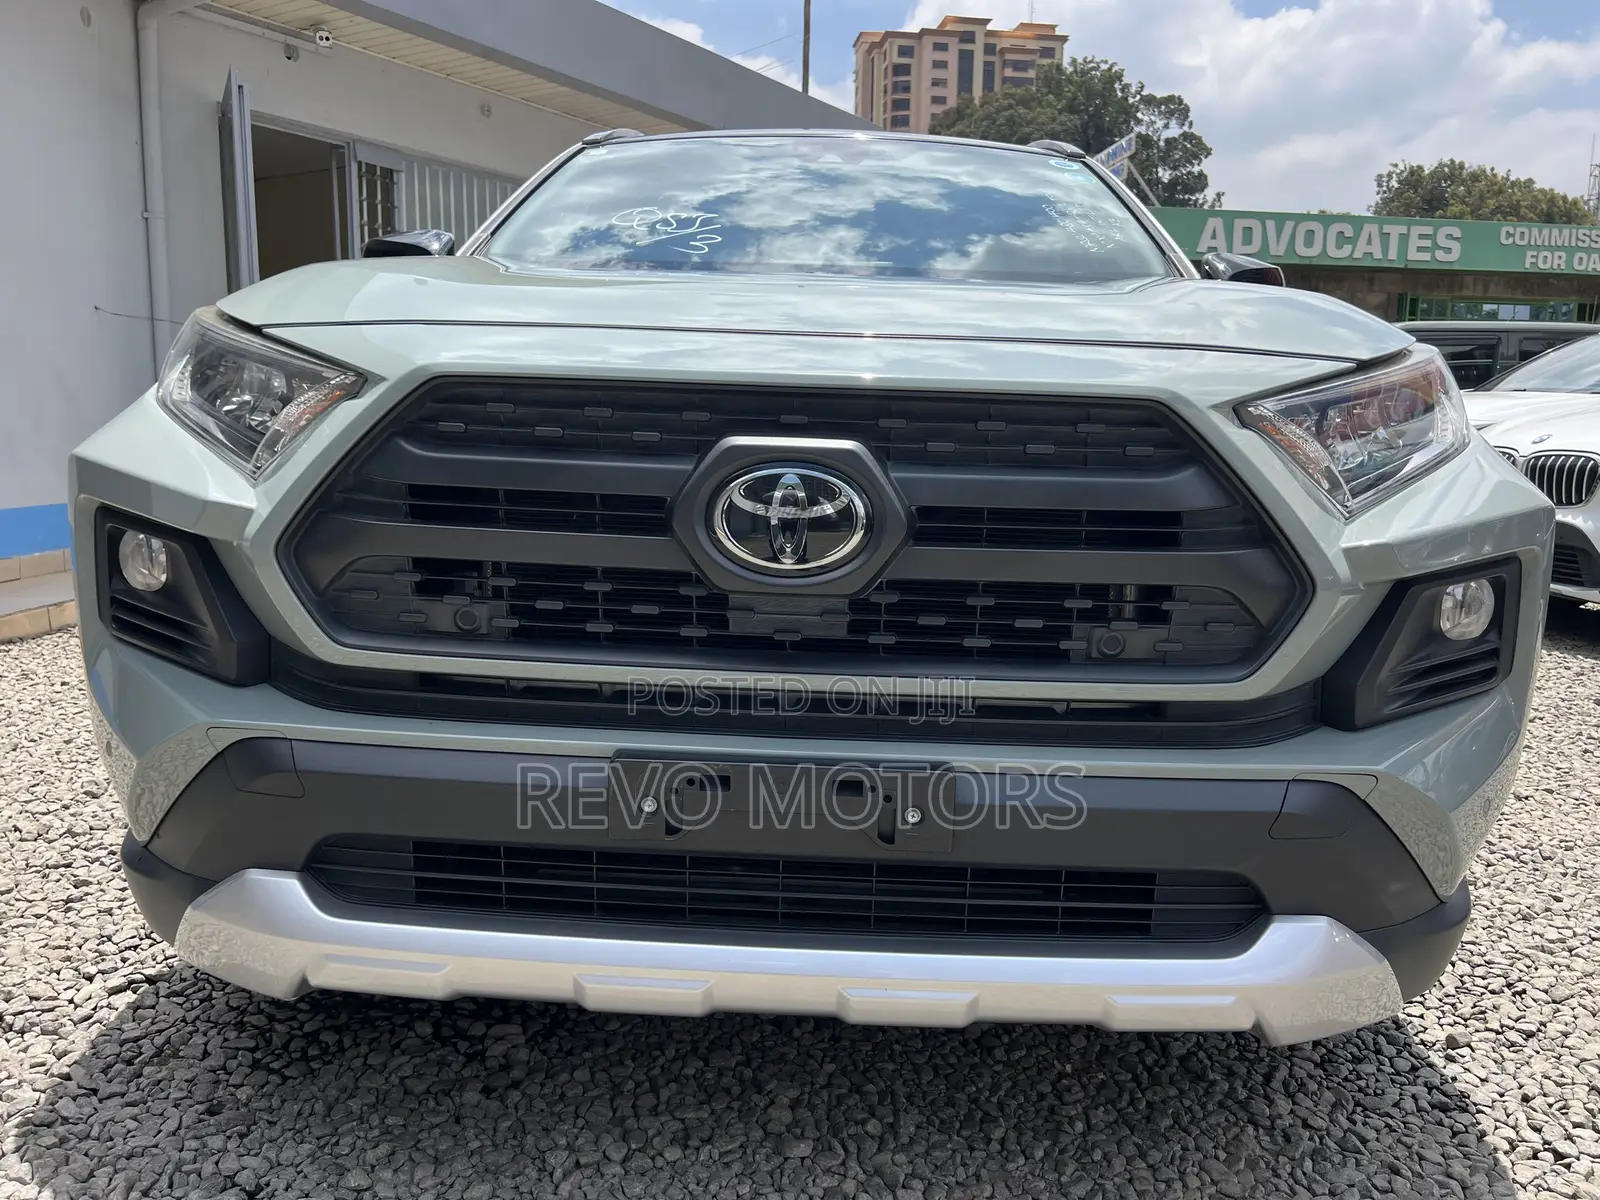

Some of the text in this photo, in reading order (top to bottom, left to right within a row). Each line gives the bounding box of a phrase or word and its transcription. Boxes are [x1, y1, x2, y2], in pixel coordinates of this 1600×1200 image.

[1196, 217, 1462, 263] ADVOCATES
[1500, 225, 1600, 249] COMMISS
[1524, 250, 1567, 270] FOR
